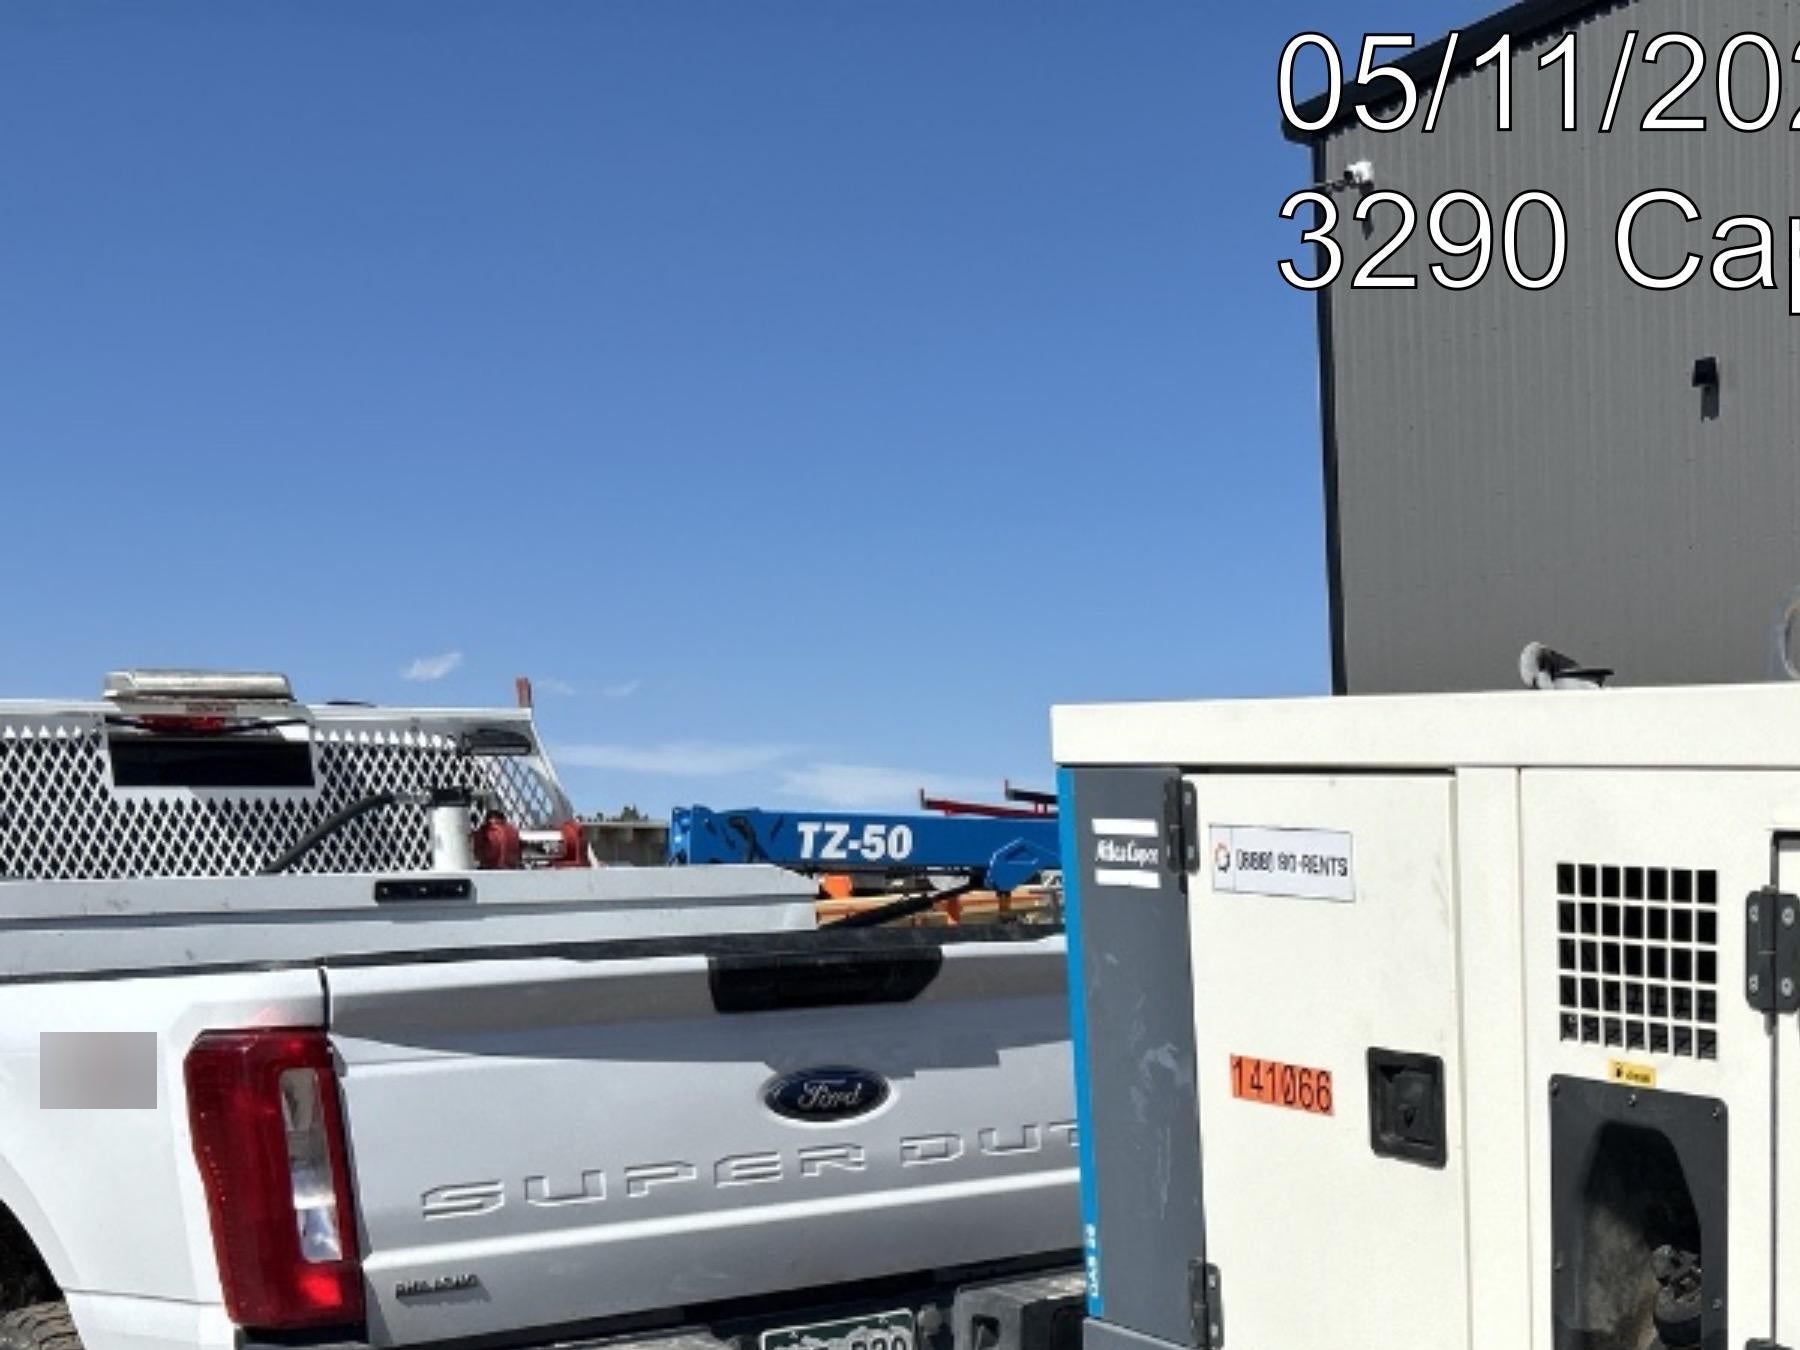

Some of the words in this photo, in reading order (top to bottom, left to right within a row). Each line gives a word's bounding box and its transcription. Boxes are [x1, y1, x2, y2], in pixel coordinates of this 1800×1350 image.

[797, 821, 914, 861] TZ-50
[797, 1077, 865, 1110] Ford
[1232, 1056, 1333, 1113] 141066
[421, 1142, 867, 1222] SUPER
